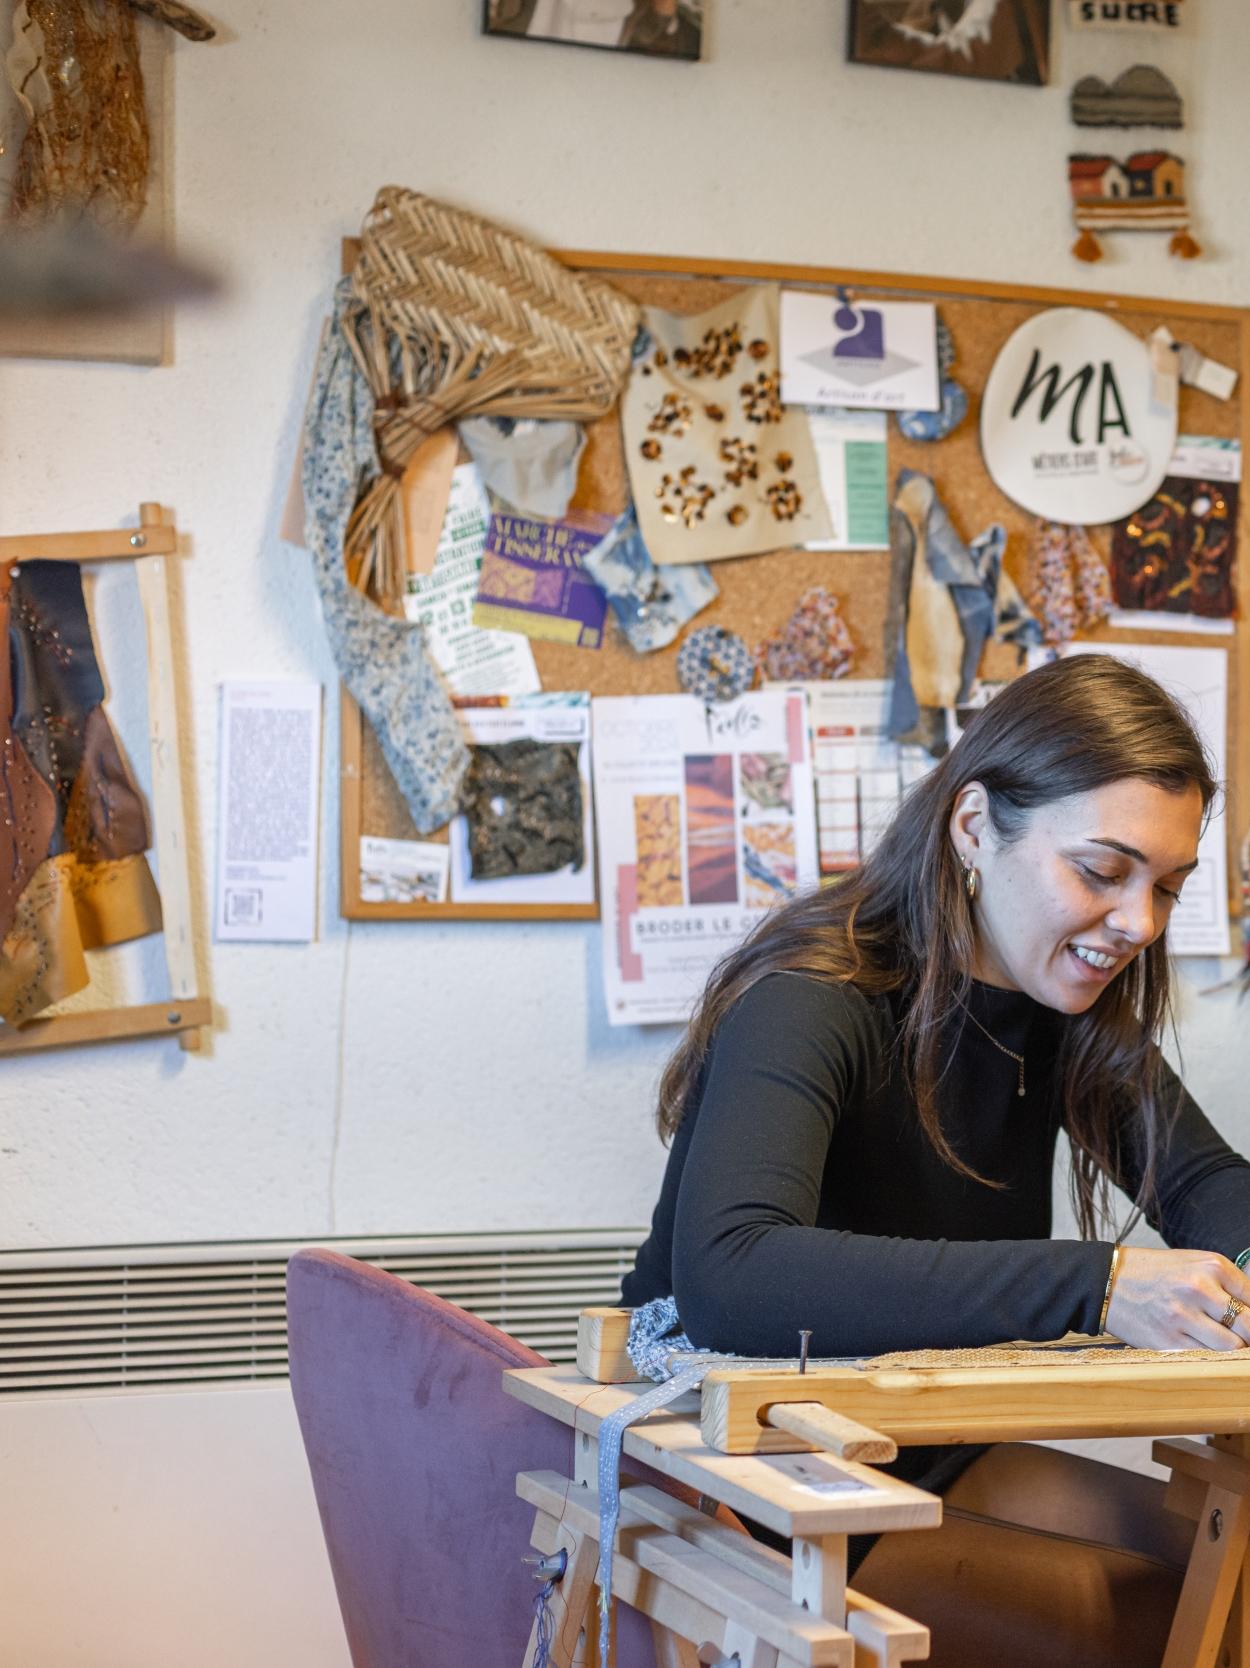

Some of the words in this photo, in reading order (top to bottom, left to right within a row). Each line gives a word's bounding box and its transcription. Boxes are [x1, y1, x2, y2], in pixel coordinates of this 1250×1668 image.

[1081, 2, 1179, 27] SUCRE
[1010, 347, 1131, 445] MA
[636, 918, 703, 934] BRODER
[712, 918, 731, 932] LE
